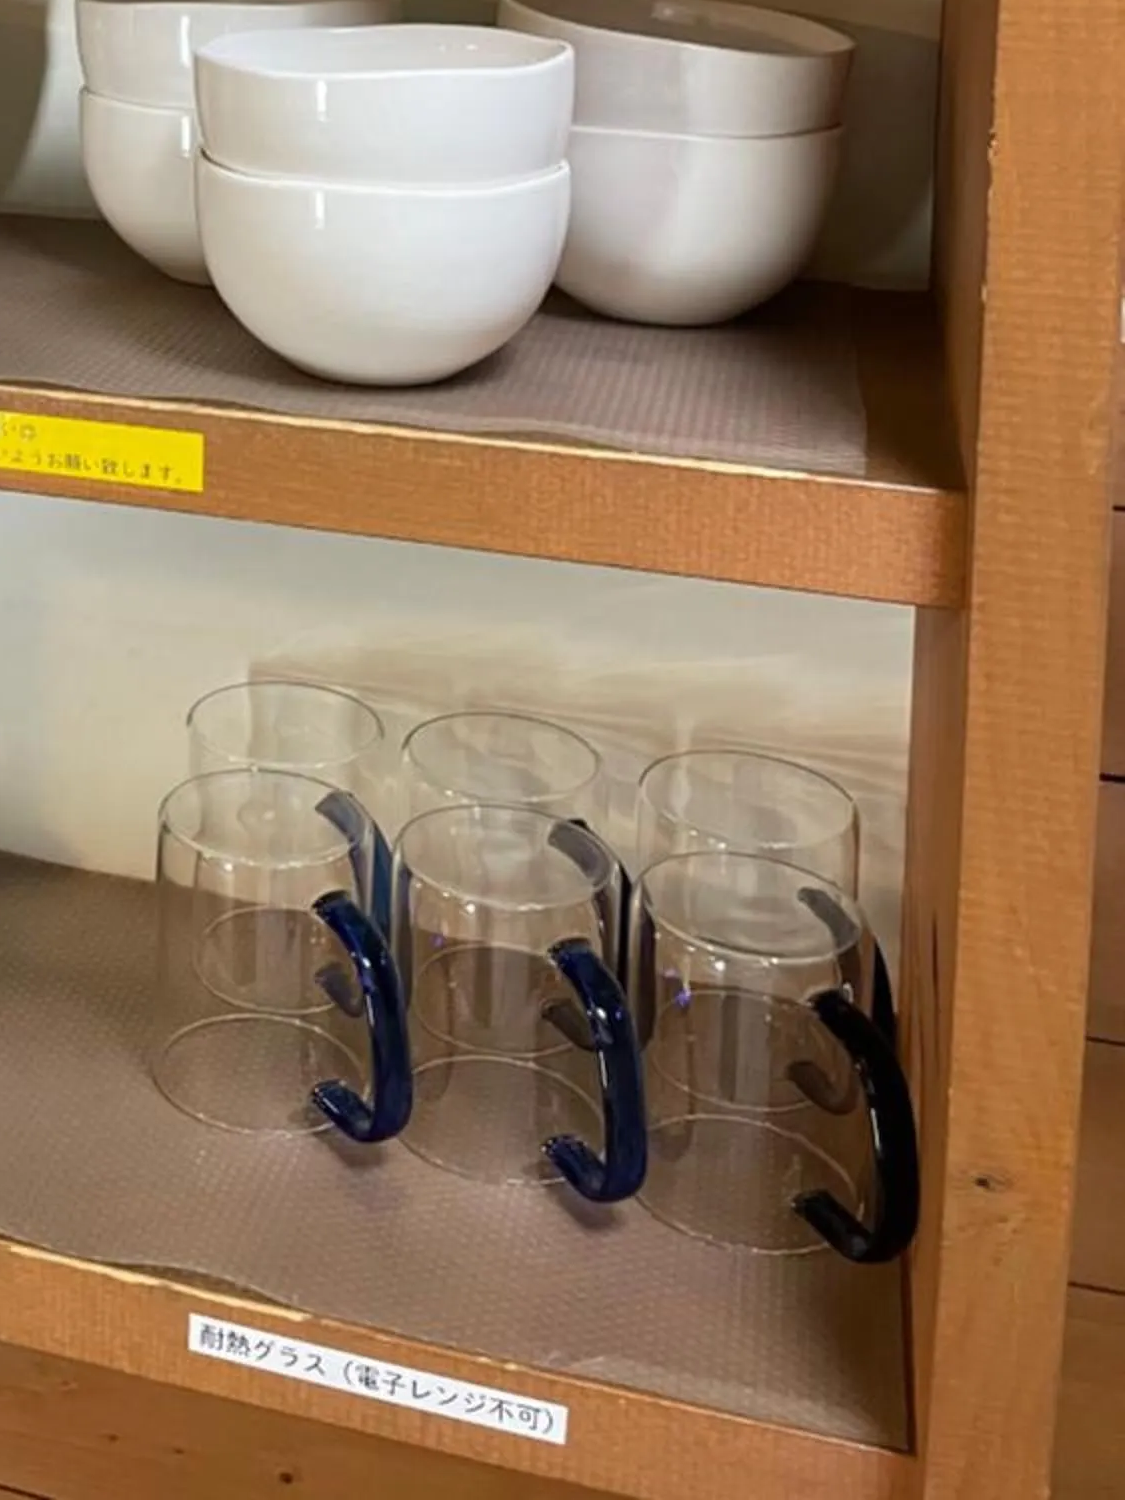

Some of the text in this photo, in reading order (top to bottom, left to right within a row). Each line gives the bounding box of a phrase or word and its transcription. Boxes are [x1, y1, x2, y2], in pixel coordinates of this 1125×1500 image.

[199, 1322, 555, 1434] 耐熱グラス（電子レンジ不可）
